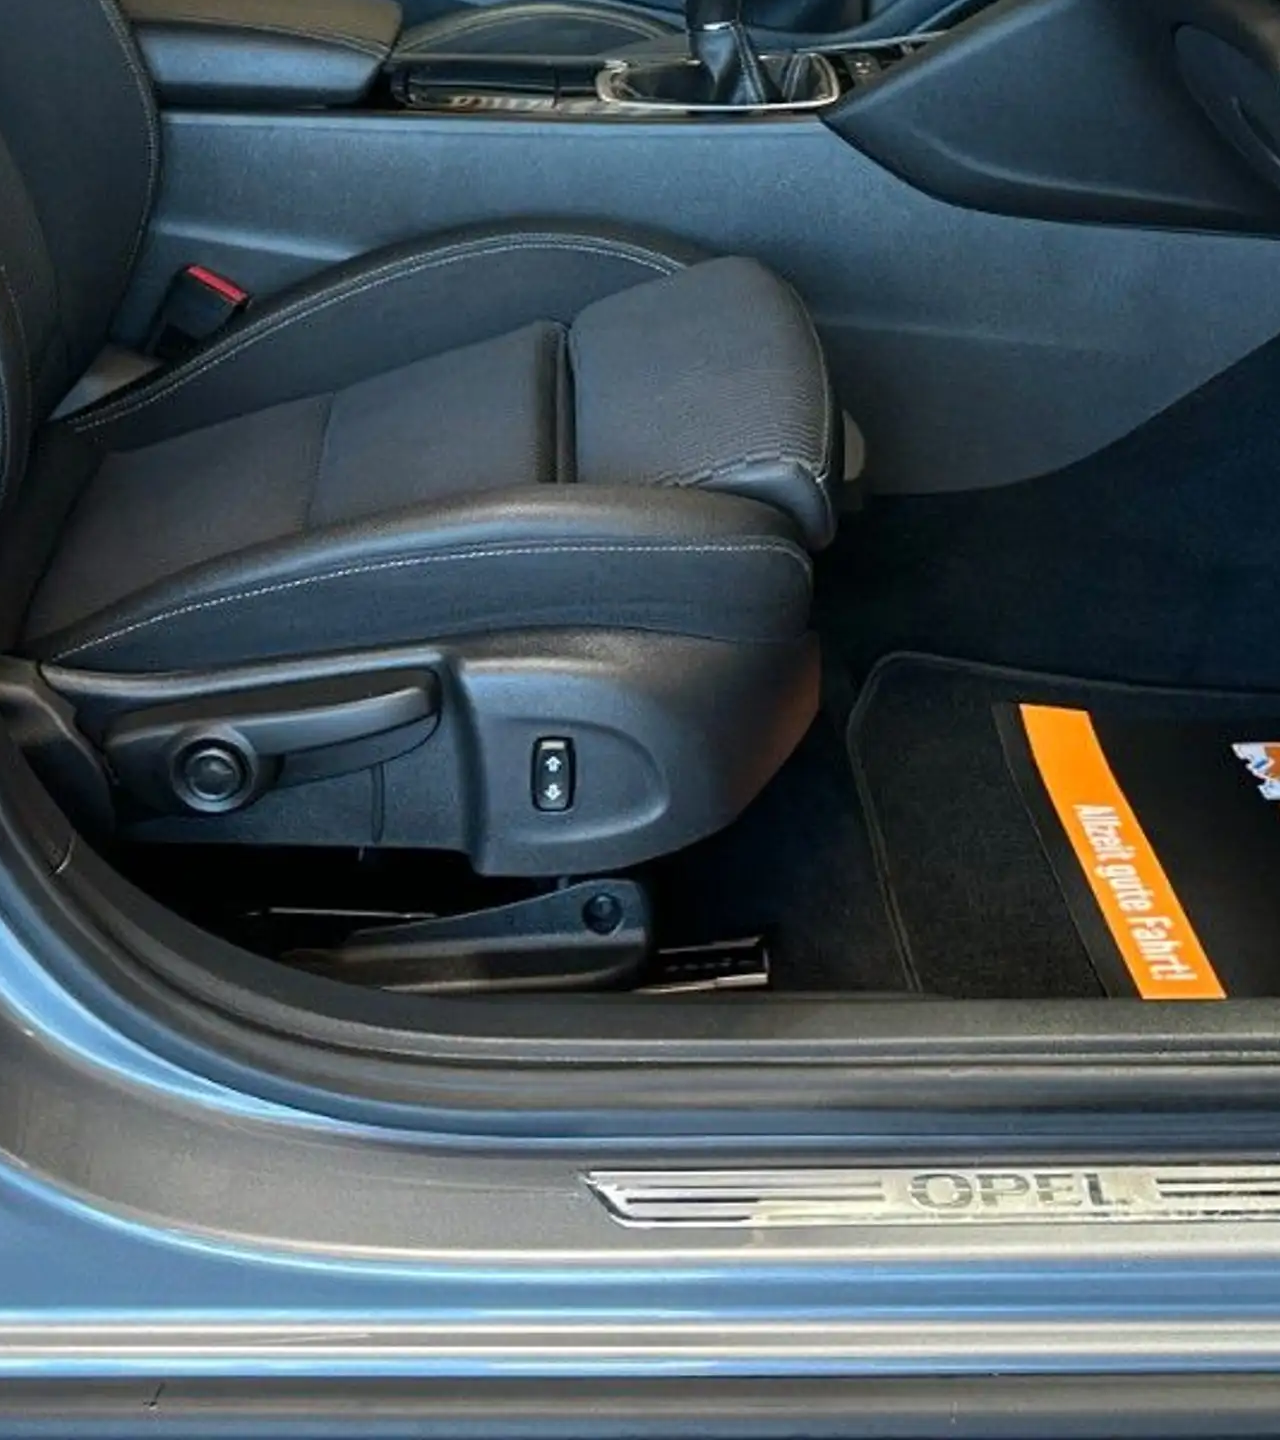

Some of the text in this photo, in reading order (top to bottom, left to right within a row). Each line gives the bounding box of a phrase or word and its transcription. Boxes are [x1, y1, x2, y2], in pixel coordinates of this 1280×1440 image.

[1072, 803, 1199, 981] Allzeit gute Fahrt!
[910, 1172, 1134, 1208] OPEL
